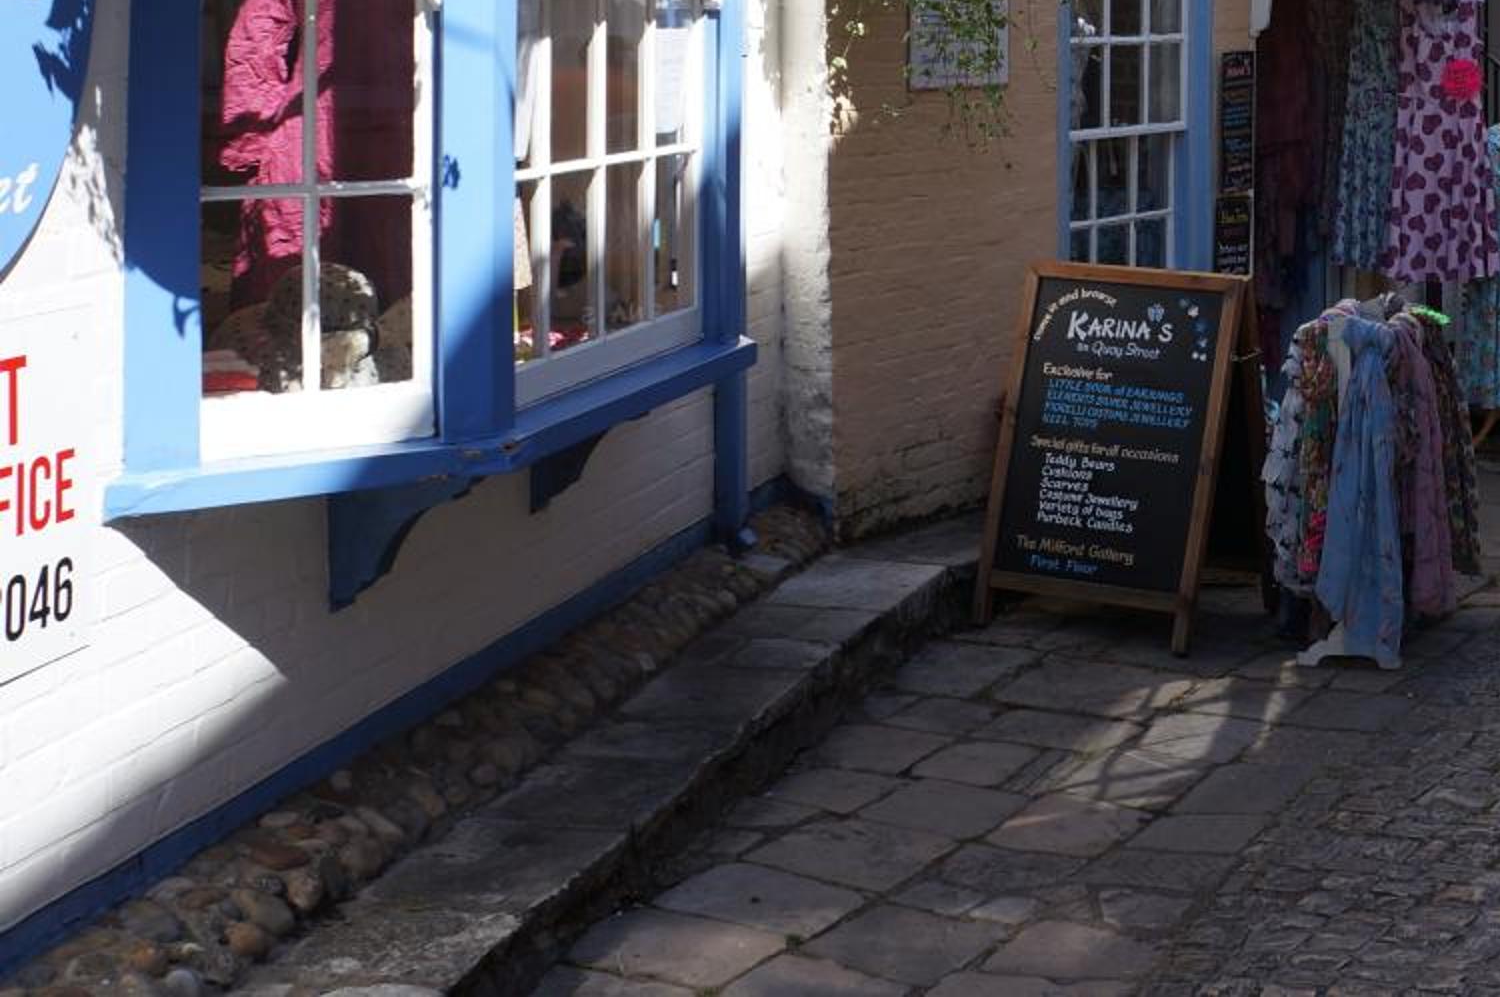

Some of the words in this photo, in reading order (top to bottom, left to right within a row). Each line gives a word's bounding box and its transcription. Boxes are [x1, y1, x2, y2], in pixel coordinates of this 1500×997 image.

[1091, 341, 1123, 358] Quay
[1125, 342, 1160, 359] Street
[1043, 362, 1094, 380] Exclusive
[1045, 452, 1077, 469] Teddy
[1082, 456, 1116, 472] Bears
[1041, 465, 1093, 480] Cushions
[1040, 477, 1089, 492] Scarves
[1039, 500, 1079, 515] Variety
[1081, 504, 1095, 515] of
[1087, 517, 1133, 533] Candles
[1089, 544, 1136, 566] Gallery
